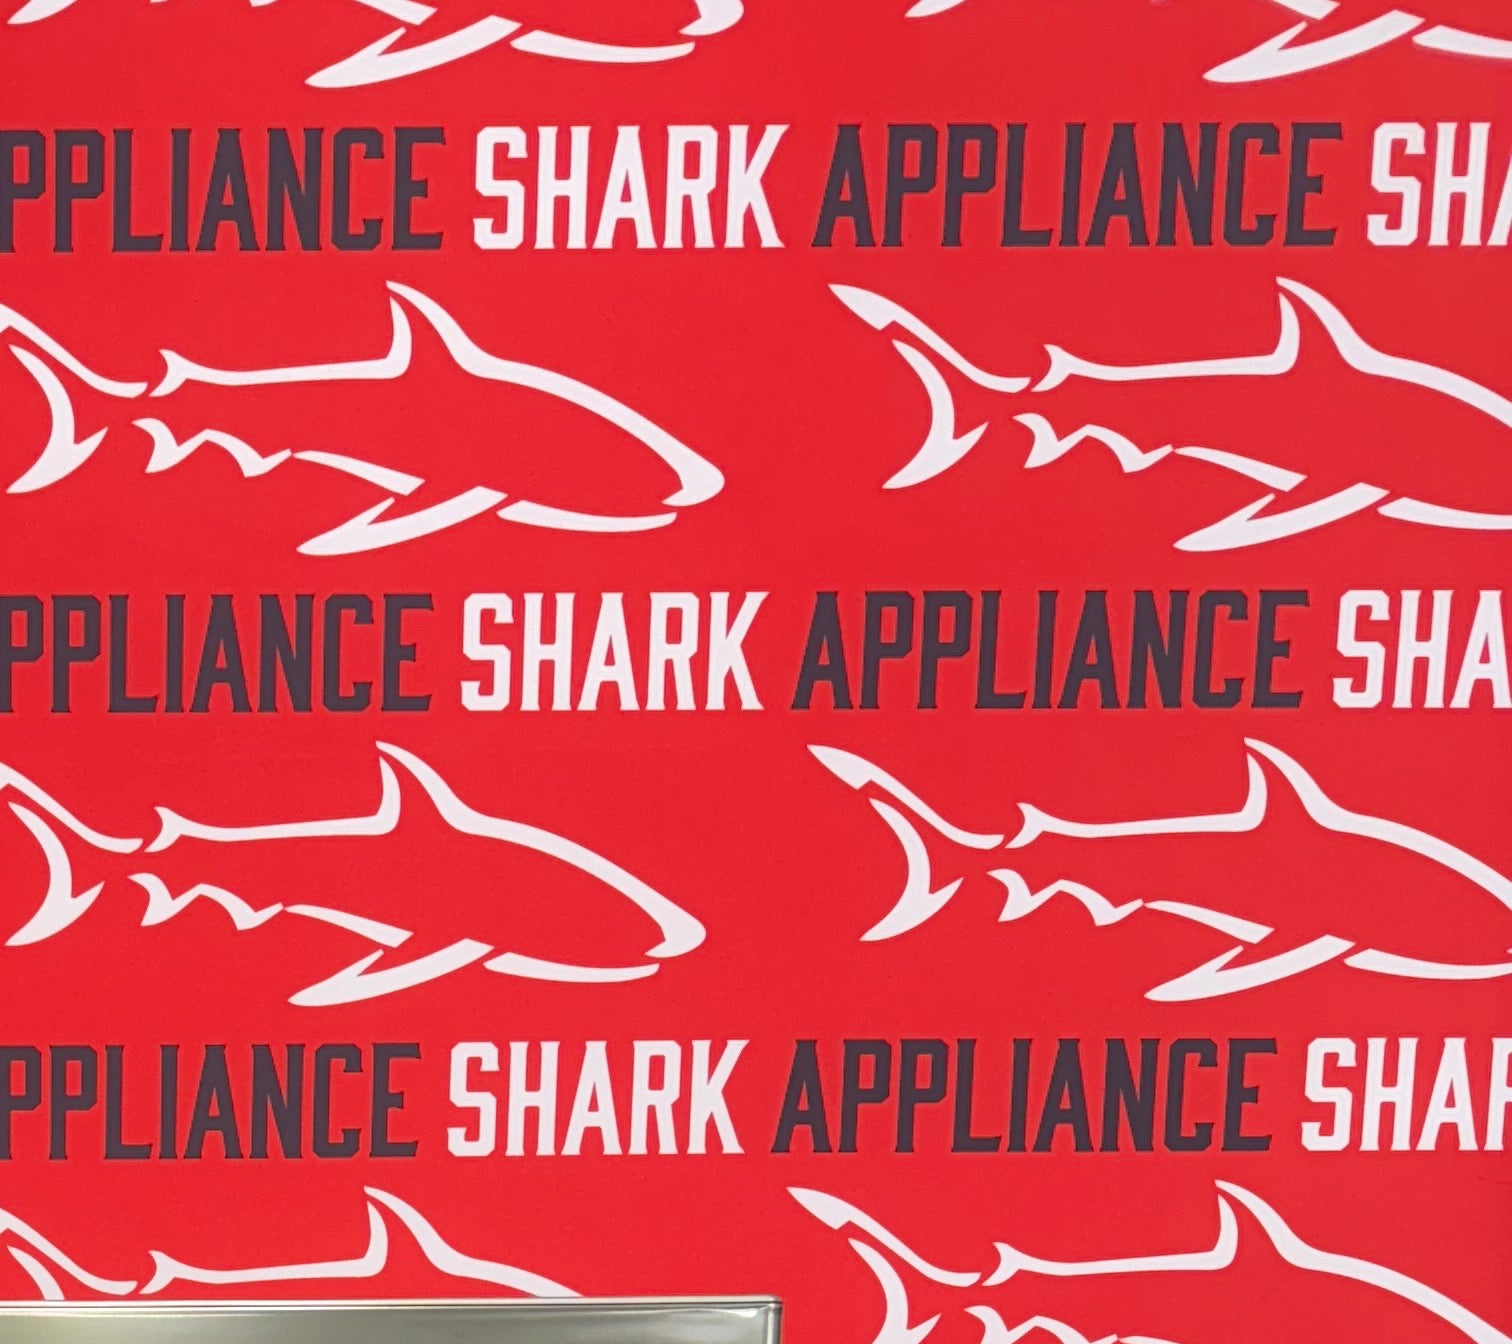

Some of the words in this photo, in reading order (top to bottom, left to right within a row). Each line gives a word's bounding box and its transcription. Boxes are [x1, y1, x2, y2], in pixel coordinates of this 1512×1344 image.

[472, 124, 790, 250] SHARK
[813, 123, 1342, 247] APPLIANCE
[460, 592, 769, 711] SHARK
[791, 591, 1309, 709] APPLIANCE
[447, 1040, 750, 1156] SHARK
[772, 1038, 1277, 1153] APPLIANCE
